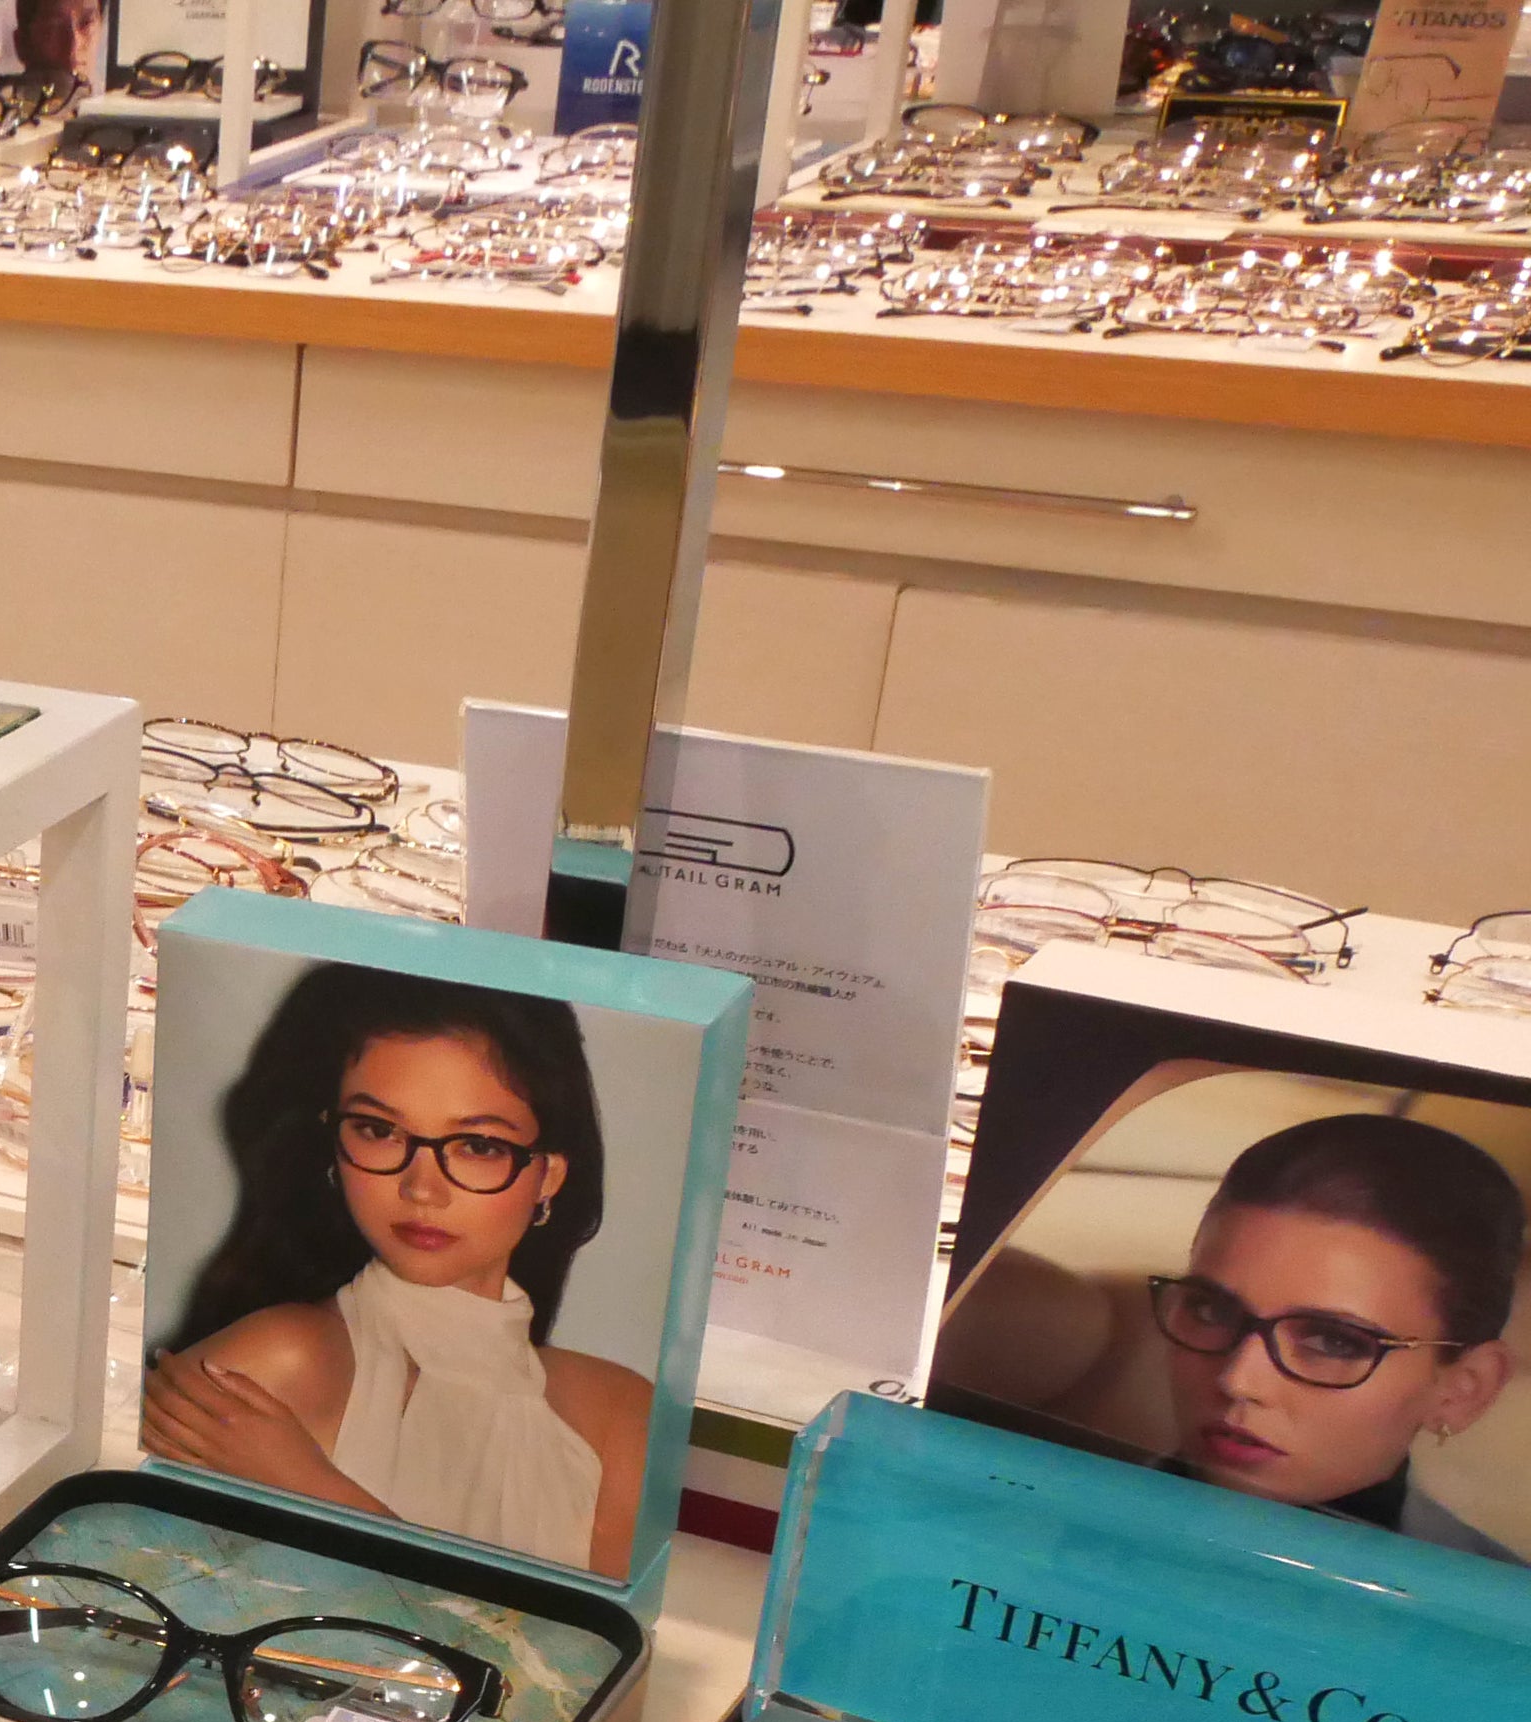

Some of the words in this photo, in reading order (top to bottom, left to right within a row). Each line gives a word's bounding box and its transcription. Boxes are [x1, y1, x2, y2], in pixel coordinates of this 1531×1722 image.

[714, 872, 782, 897] GRAM
[735, 1256, 792, 1279] GRAM
[950, 1577, 1236, 1702] TIFFANY
